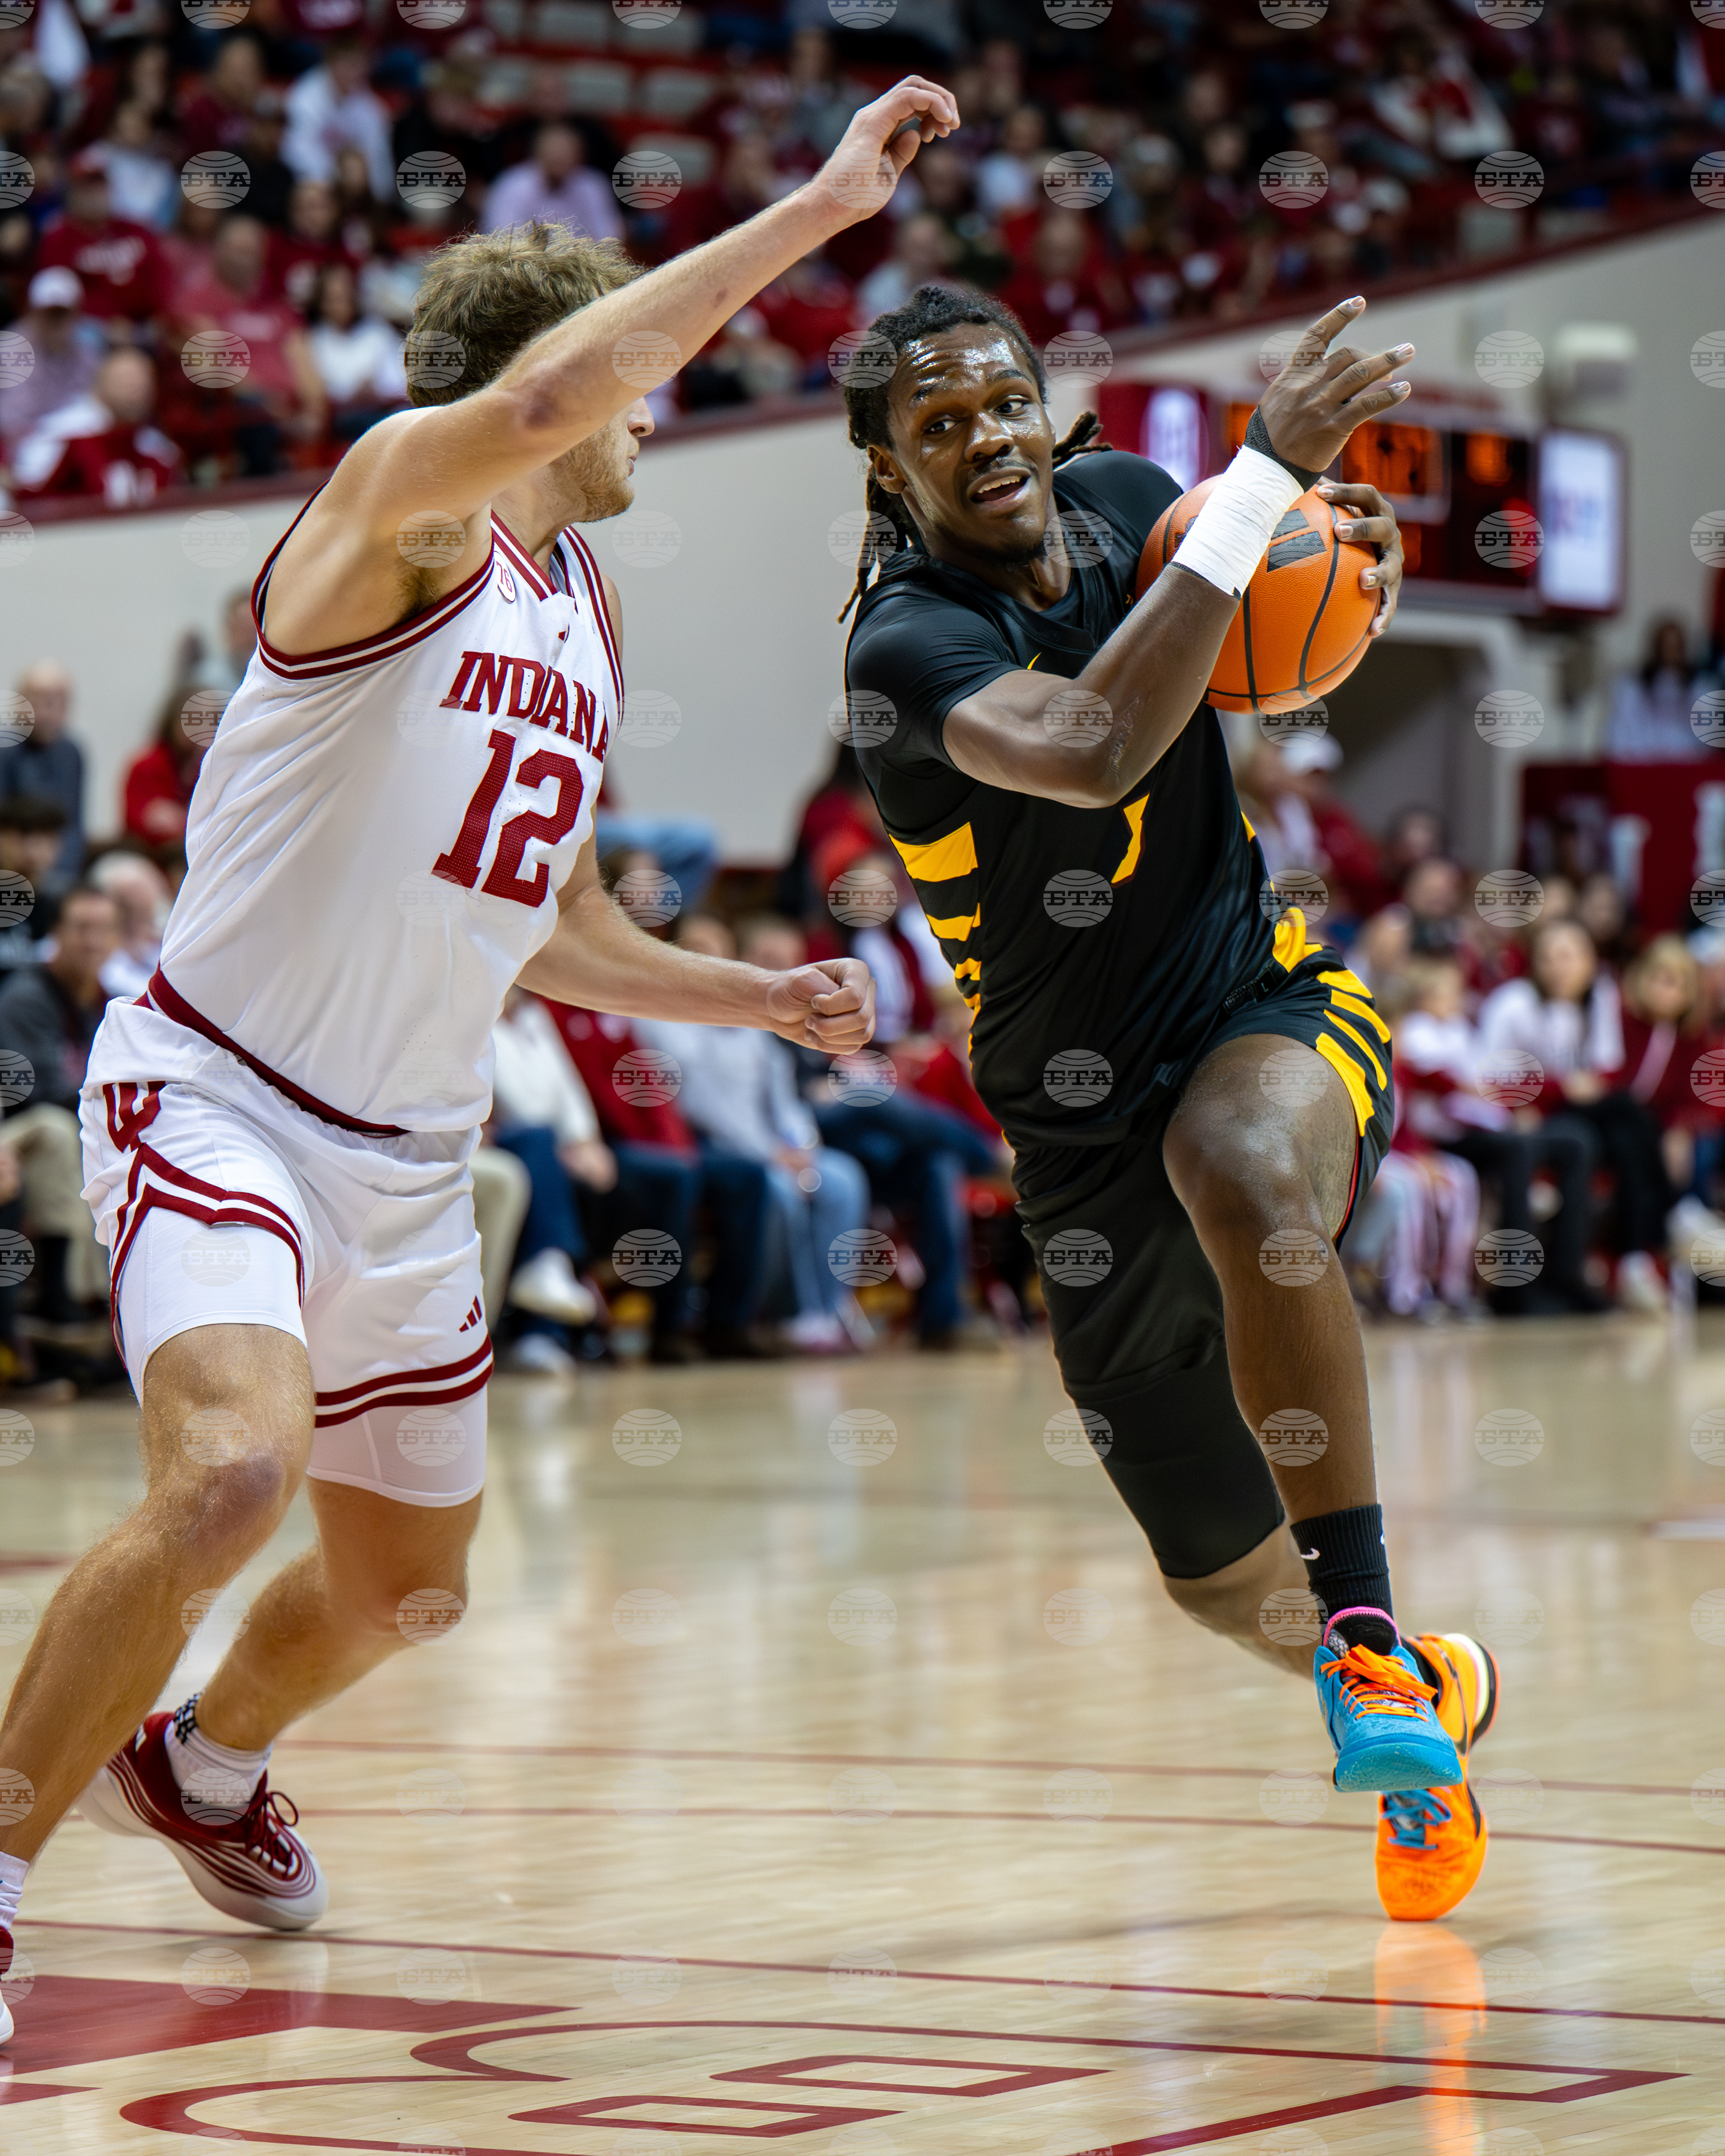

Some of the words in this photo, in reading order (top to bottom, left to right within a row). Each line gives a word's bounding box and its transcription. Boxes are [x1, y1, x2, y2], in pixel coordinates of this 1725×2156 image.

[495, 560, 512, 593] 76
[440, 650, 609, 764] INDIANA
[431, 729, 584, 909] 12
